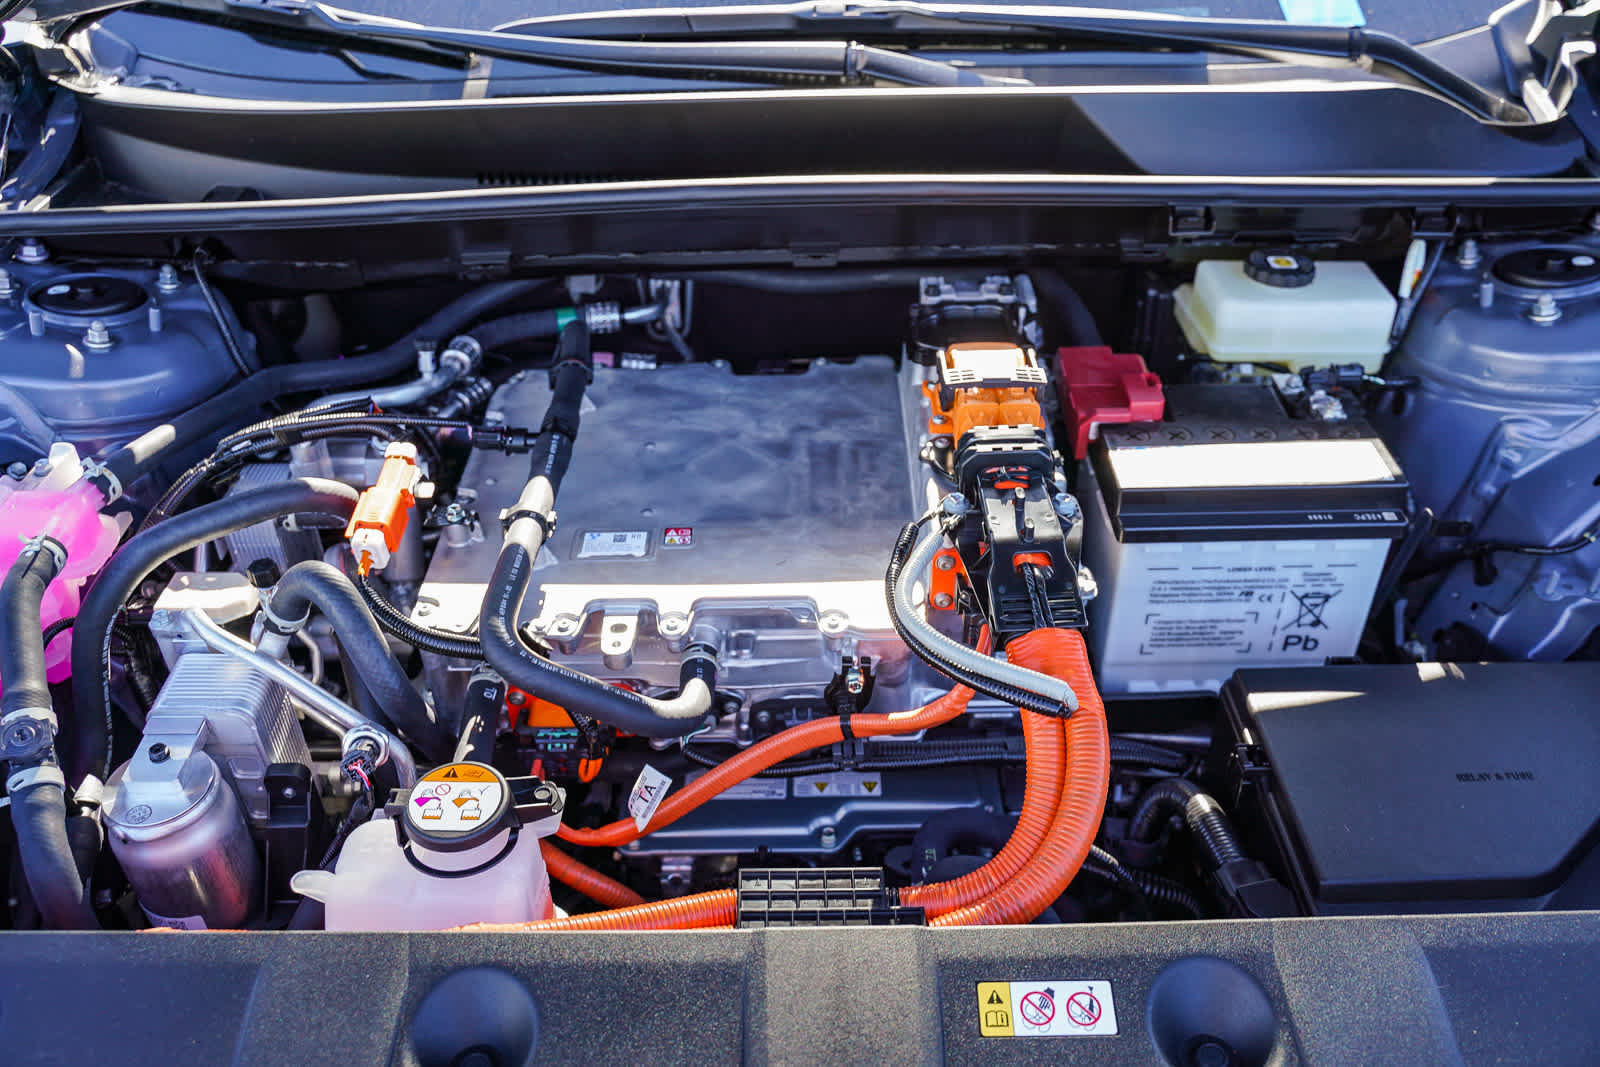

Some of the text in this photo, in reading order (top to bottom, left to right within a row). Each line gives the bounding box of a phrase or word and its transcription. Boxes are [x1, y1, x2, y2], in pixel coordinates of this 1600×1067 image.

[1282, 634, 1319, 652] Pb
[1456, 772, 1490, 782] RELAY
[636, 784, 657, 804] TA
